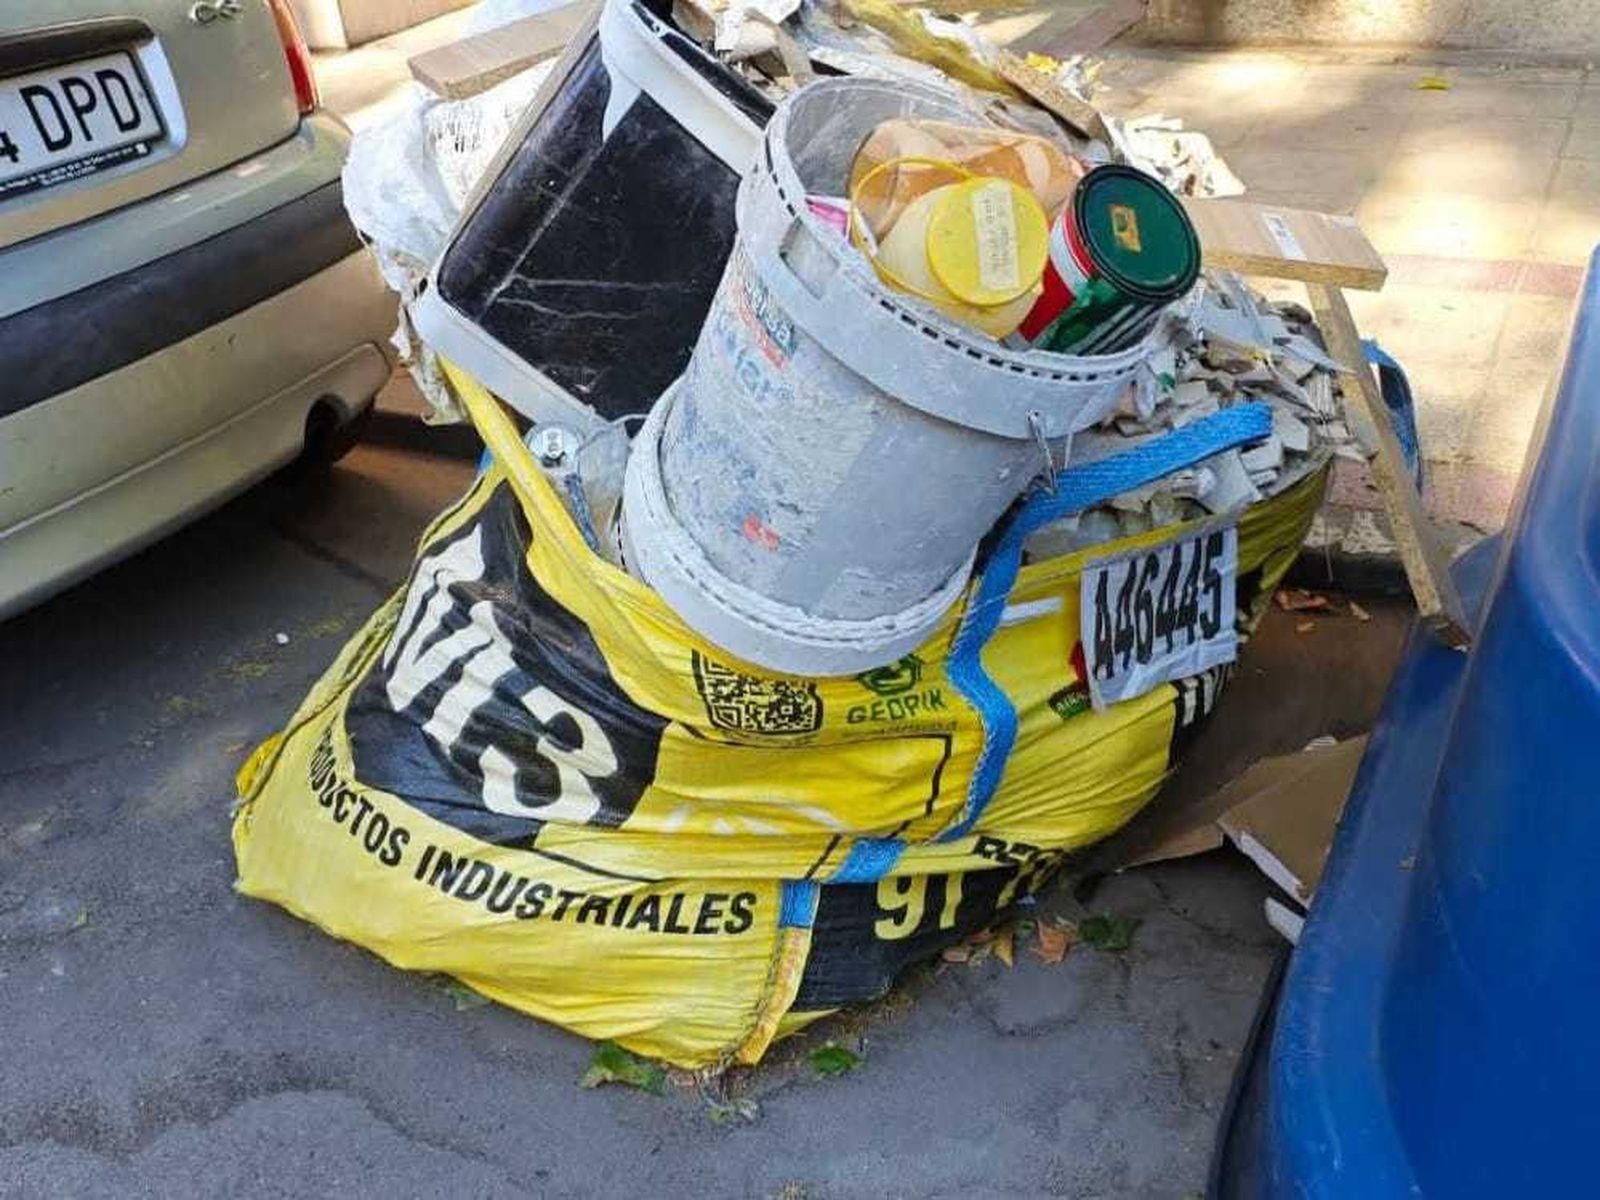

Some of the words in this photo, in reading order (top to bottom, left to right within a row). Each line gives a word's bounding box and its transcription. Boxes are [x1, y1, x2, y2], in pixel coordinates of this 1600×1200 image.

[18, 68, 142, 152] DPD
[1092, 531, 1224, 680] A46445
[414, 845, 758, 936] INDUSTRIALES
